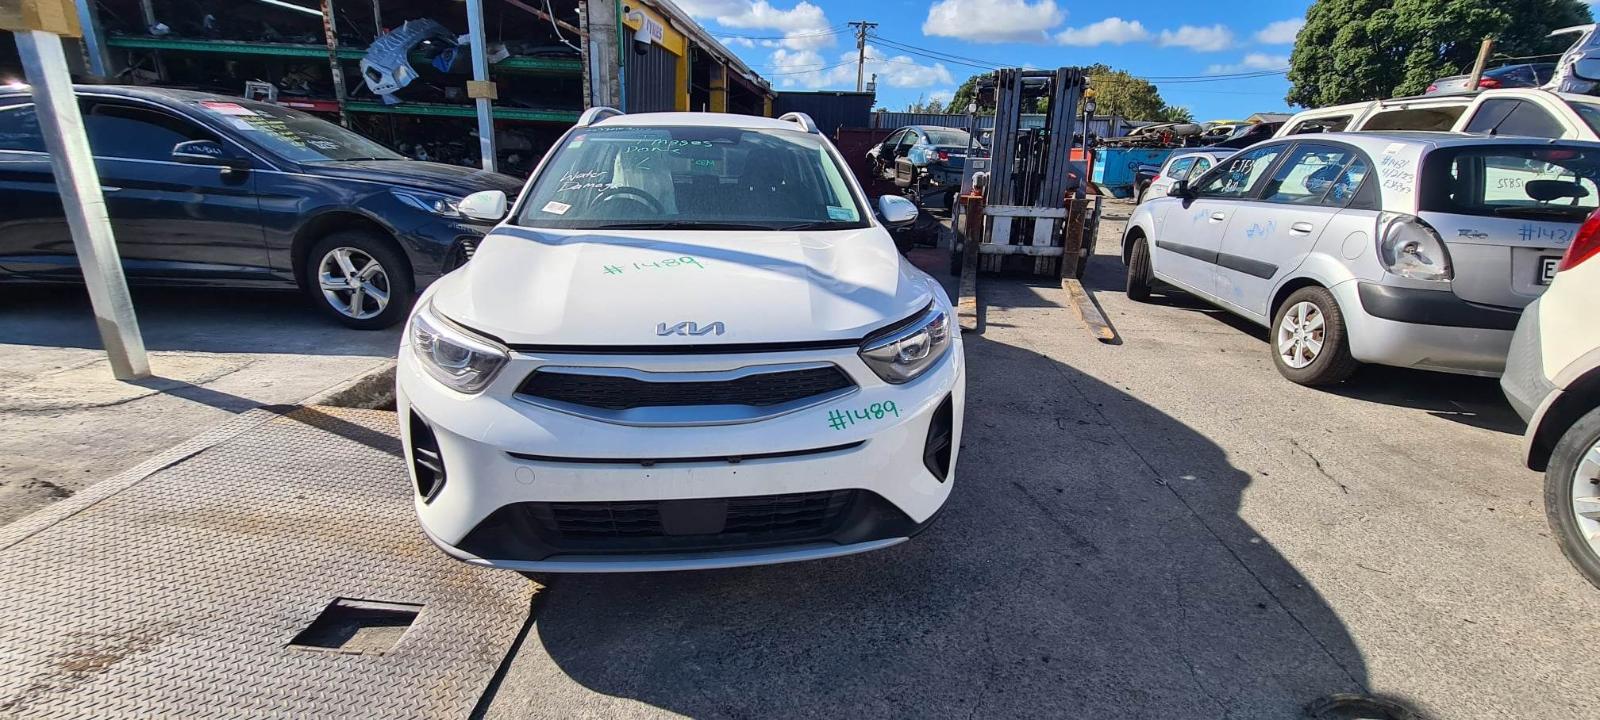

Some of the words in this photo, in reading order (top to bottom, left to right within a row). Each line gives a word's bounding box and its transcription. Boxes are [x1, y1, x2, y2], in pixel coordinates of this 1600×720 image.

[1457, 229, 1489, 239] Rio
[603, 256, 704, 275] #1489
[656, 321, 725, 336] KIA
